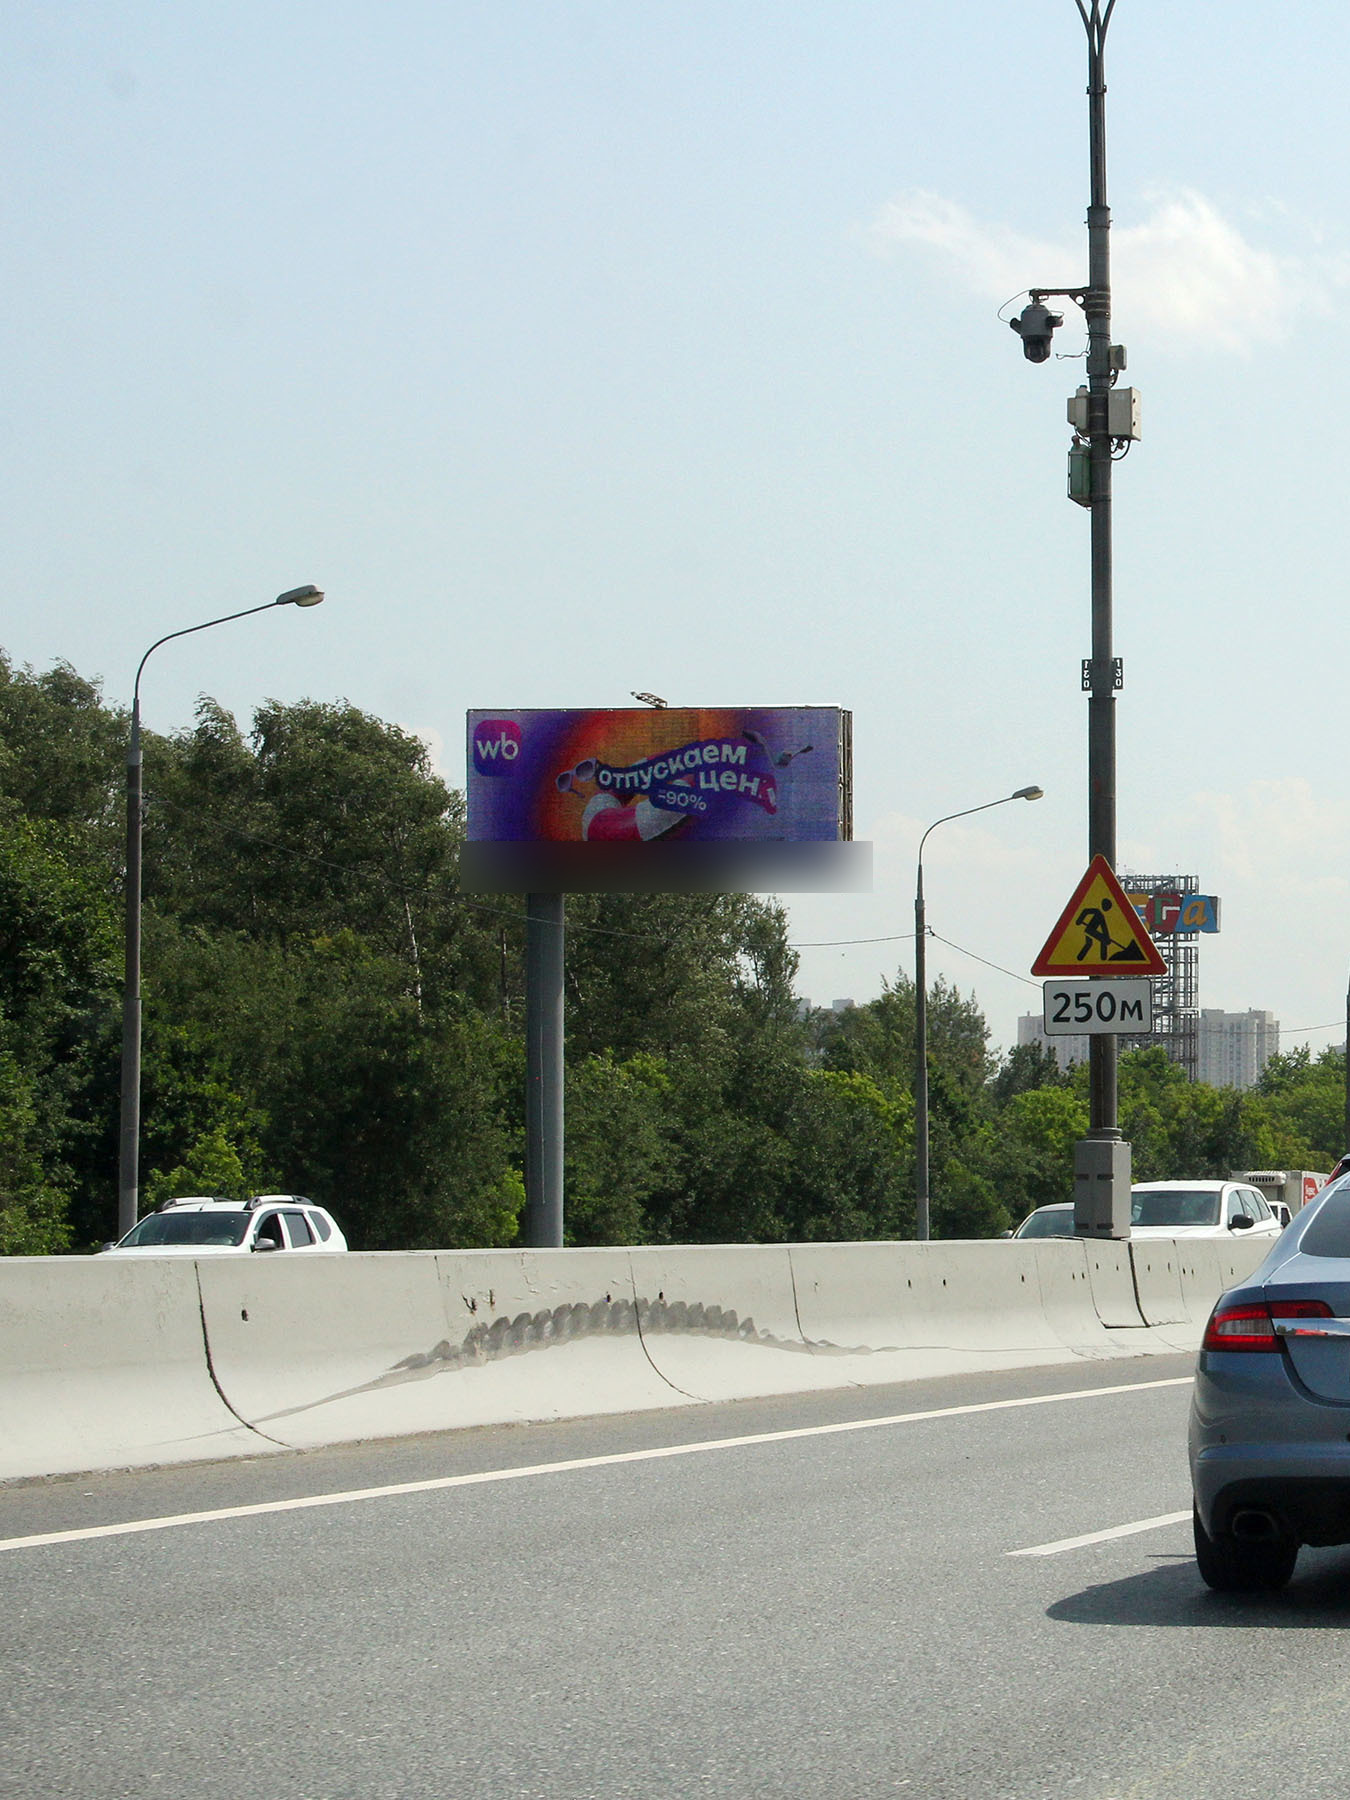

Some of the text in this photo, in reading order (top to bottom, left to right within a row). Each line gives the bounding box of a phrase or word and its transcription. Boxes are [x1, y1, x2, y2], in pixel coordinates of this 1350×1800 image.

[476, 731, 519, 760] wb
[599, 744, 748, 790] отпускаем
[658, 790, 707, 811] -90%
[1052, 991, 1143, 1024] 250м
